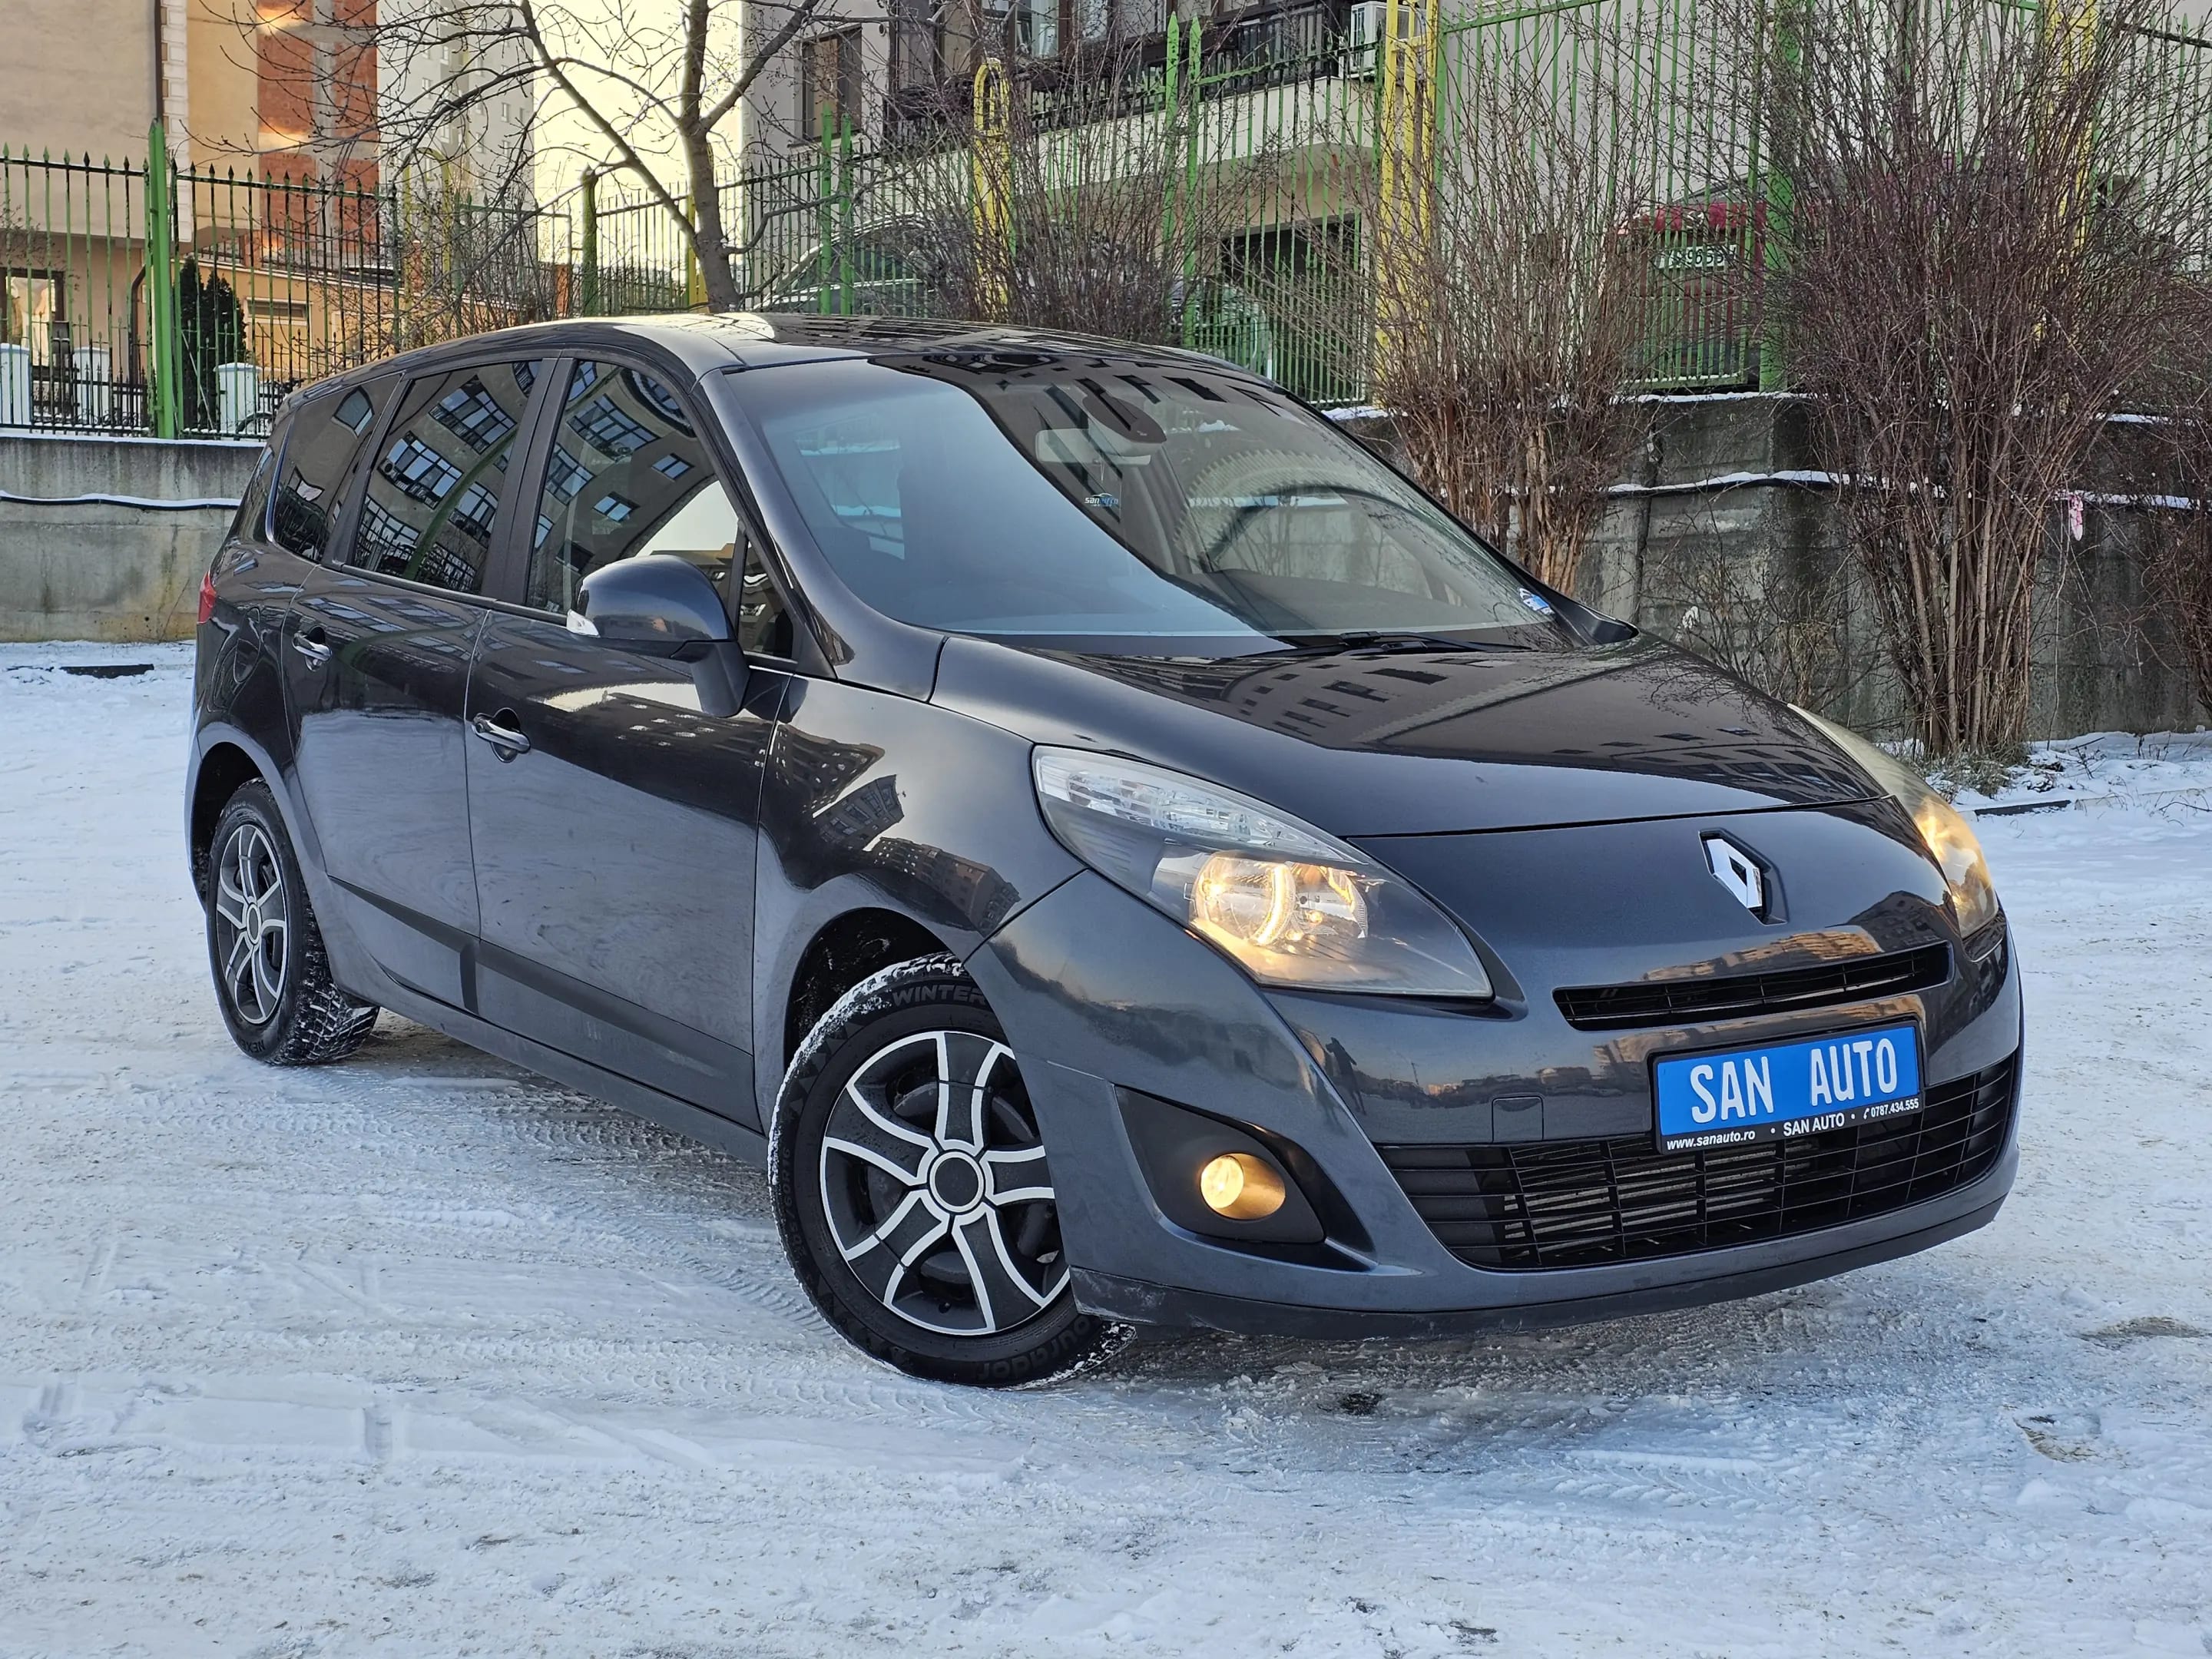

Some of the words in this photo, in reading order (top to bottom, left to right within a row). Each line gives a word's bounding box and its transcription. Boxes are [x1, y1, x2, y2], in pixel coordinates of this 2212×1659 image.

[892, 984, 986, 1007] WINTER
[1690, 1056, 1774, 1124] SAN
[1811, 1038, 1898, 1107] AUTO
[1666, 1129, 1756, 1151] www.sanauto.ro
[1783, 1119, 1810, 1137] SAN
[1813, 1112, 1845, 1133] AUTO
[1870, 1098, 1919, 1118] 0787.434.555
[976, 1315, 1091, 1382] ourador
